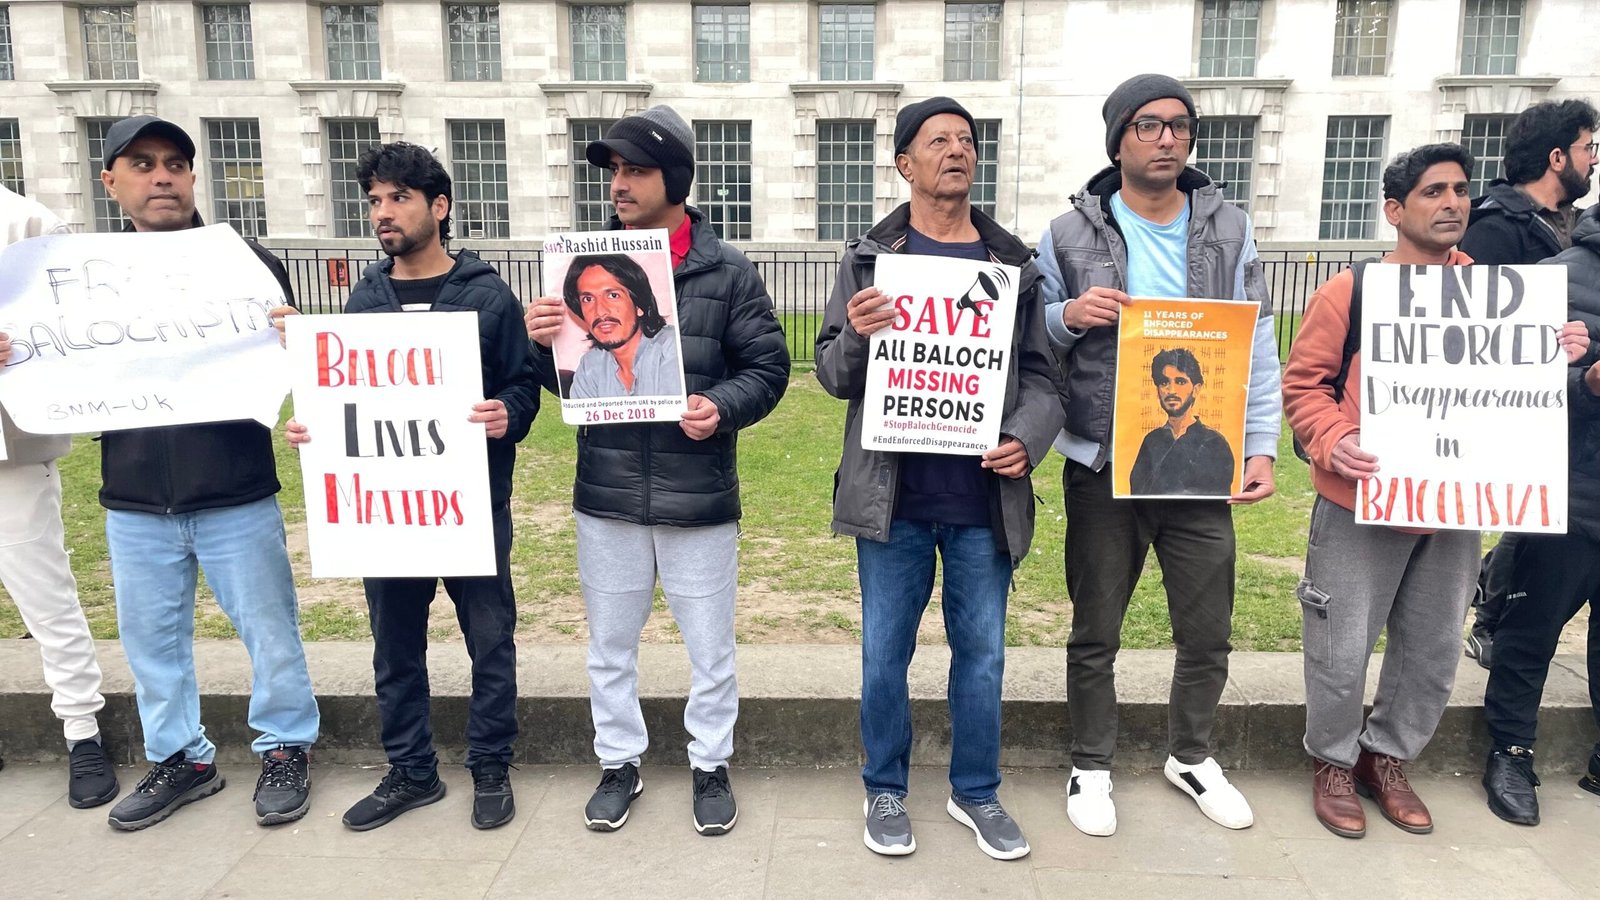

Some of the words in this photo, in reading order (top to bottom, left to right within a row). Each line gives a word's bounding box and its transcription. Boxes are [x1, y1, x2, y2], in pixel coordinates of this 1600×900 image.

[544, 242, 565, 254] SAVE
[565, 237, 608, 254] Rashid
[612, 235, 663, 252] Hussain
[1399, 264, 1525, 319] END
[891, 294, 994, 338] SAVE
[1143, 320, 1193, 329] ENFORCED
[1156, 311, 1188, 320] YEARS
[1191, 312, 1204, 320] OF
[1143, 329, 1229, 339] DISAPPEARANCES
[1371, 322, 1561, 366] ENFORCED
[316, 331, 443, 388] BALOCH
[913, 342, 1004, 371] BALOCH
[887, 367, 980, 395] MISSING
[597, 400, 623, 408] Deported
[658, 398, 674, 406] police
[883, 395, 985, 423] PERSONS
[1367, 375, 1565, 420] Disappearances
[585, 410, 600, 422] 26
[603, 409, 624, 421] Dec
[627, 408, 656, 420] 2018
[883, 420, 978, 434] #StopBalochGenocide
[344, 403, 445, 457] LIVES
[872, 435, 988, 450] #EndEnforcedDisappearances
[1435, 433, 1465, 459] in
[324, 473, 464, 526] MATTERS
